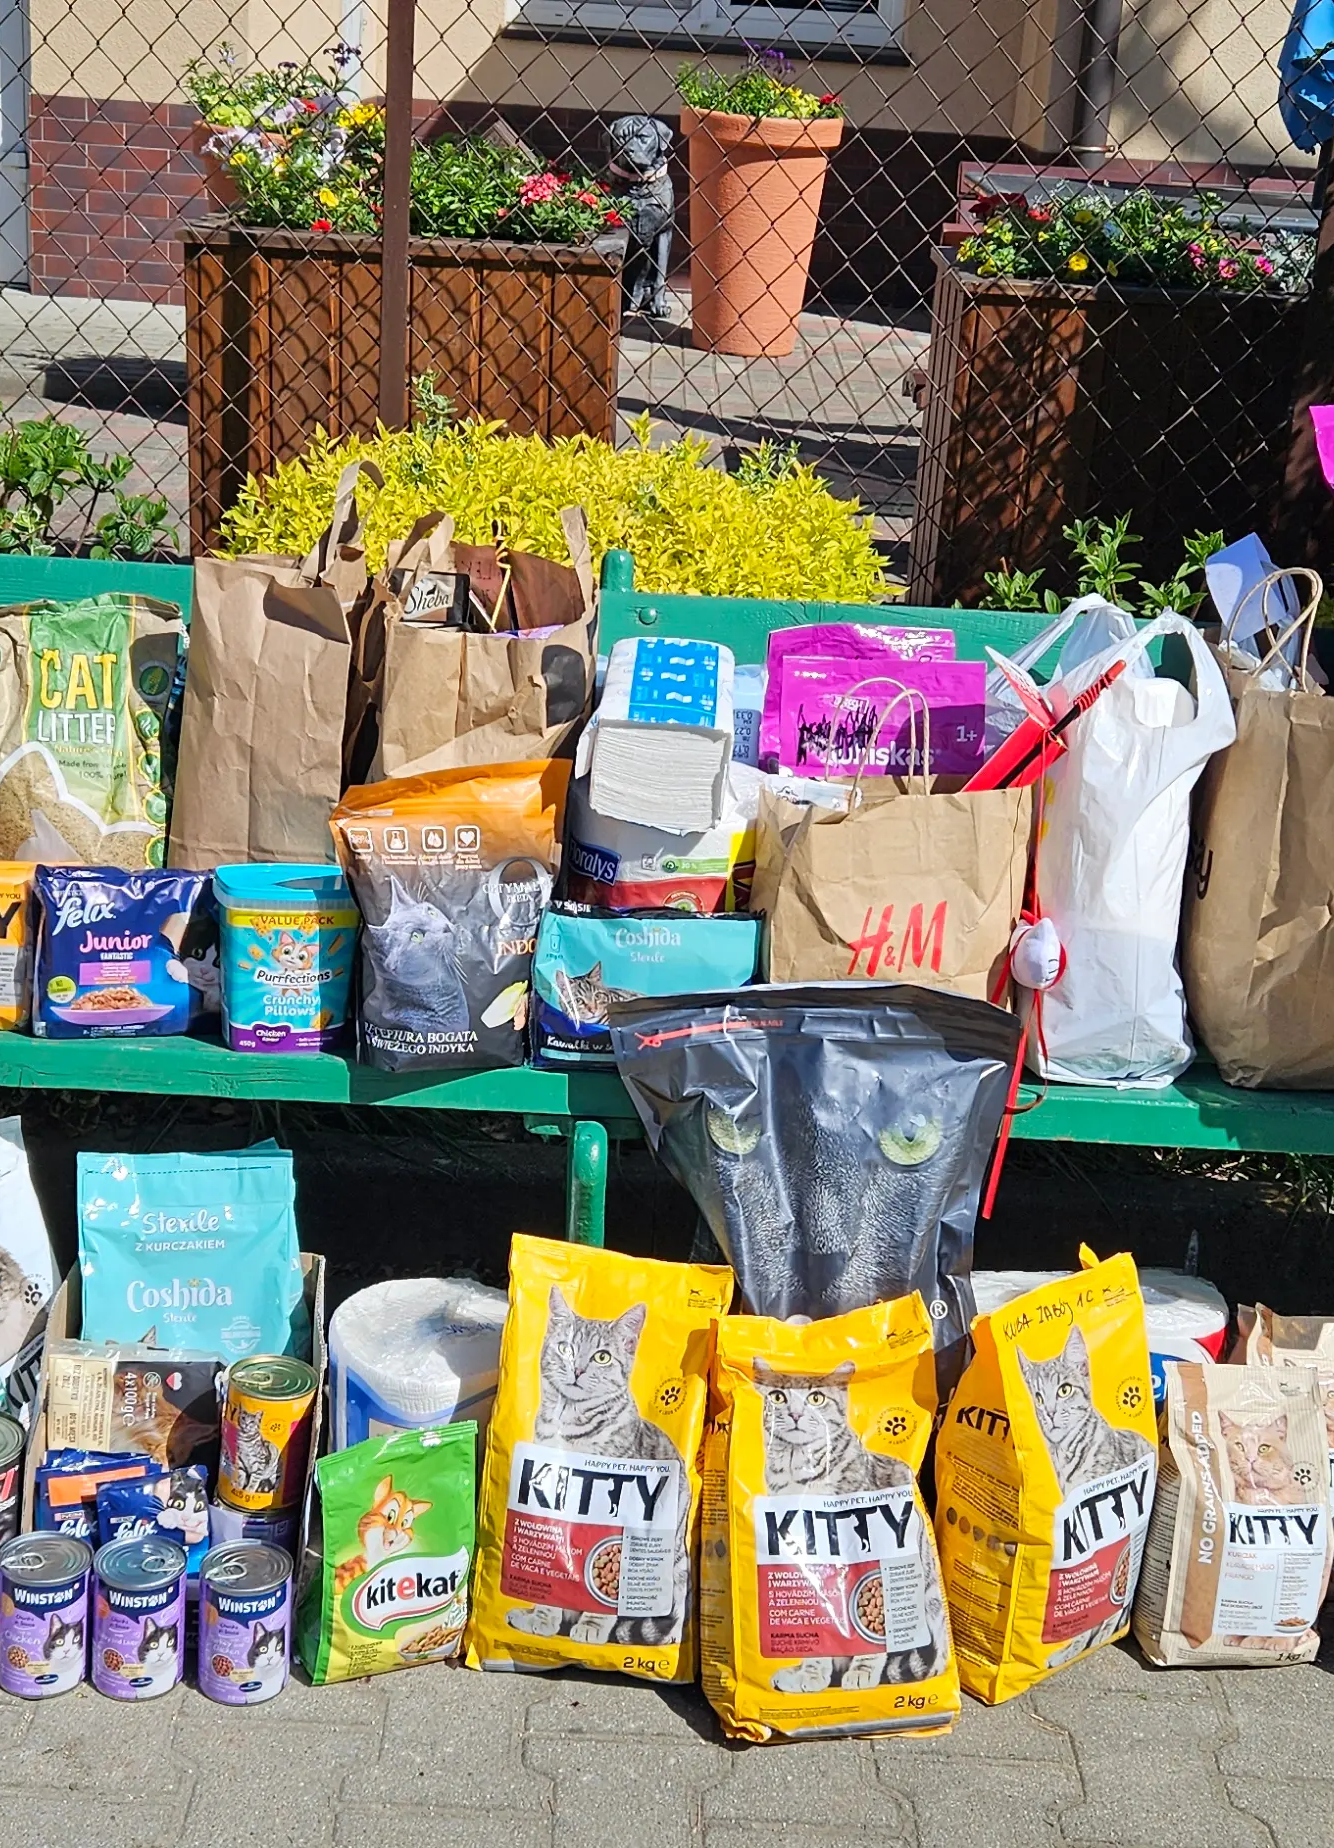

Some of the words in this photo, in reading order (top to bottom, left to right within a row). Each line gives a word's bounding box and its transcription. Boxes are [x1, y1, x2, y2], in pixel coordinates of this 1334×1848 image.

[405, 585, 452, 615] Sheba
[40, 649, 117, 710] CAT
[956, 725, 977, 743] 1+
[58, 759, 80, 770] Made
[52, 896, 116, 936] felix
[261, 916, 301, 925] VALUE
[303, 916, 334, 925] PACK
[79, 930, 152, 953] Junior
[615, 928, 681, 948] Coshida
[847, 900, 947, 977] H&M
[263, 995, 320, 1007] Crunchy
[265, 1006, 317, 1016] Pillows
[427, 1030, 478, 1044] BOGATA
[372, 1038, 425, 1055] ŚWIEŻEGO
[428, 1043, 474, 1054] INDYKA
[142, 1209, 220, 1235] Sterile
[135, 1242, 143, 1251] Z
[145, 1239, 225, 1251] KURCZAKIEM
[127, 1278, 232, 1313] Coshida
[585, 1460, 612, 1469] HAPPY
[517, 1458, 670, 1521] KITTY
[1084, 1481, 1105, 1496] HAPPY
[823, 1498, 850, 1508] HAPPY
[869, 1493, 894, 1503] HAPPY
[1200, 1470, 1217, 1534] GRAINS
[1063, 1469, 1149, 1562] KITTY
[764, 1501, 914, 1556] KITTY
[1229, 1513, 1319, 1546] KITTY
[1198, 1538, 1215, 1564] NO
[521, 1563, 539, 1574] VACA
[367, 1571, 457, 1610] kitekat
[776, 1598, 818, 1606] ZELENINOU
[769, 1609, 787, 1617] COM
[623, 1657, 634, 1669] 2
[638, 1656, 655, 1671] kg
[894, 1696, 905, 1708] 2
[908, 1695, 925, 1708] kg
